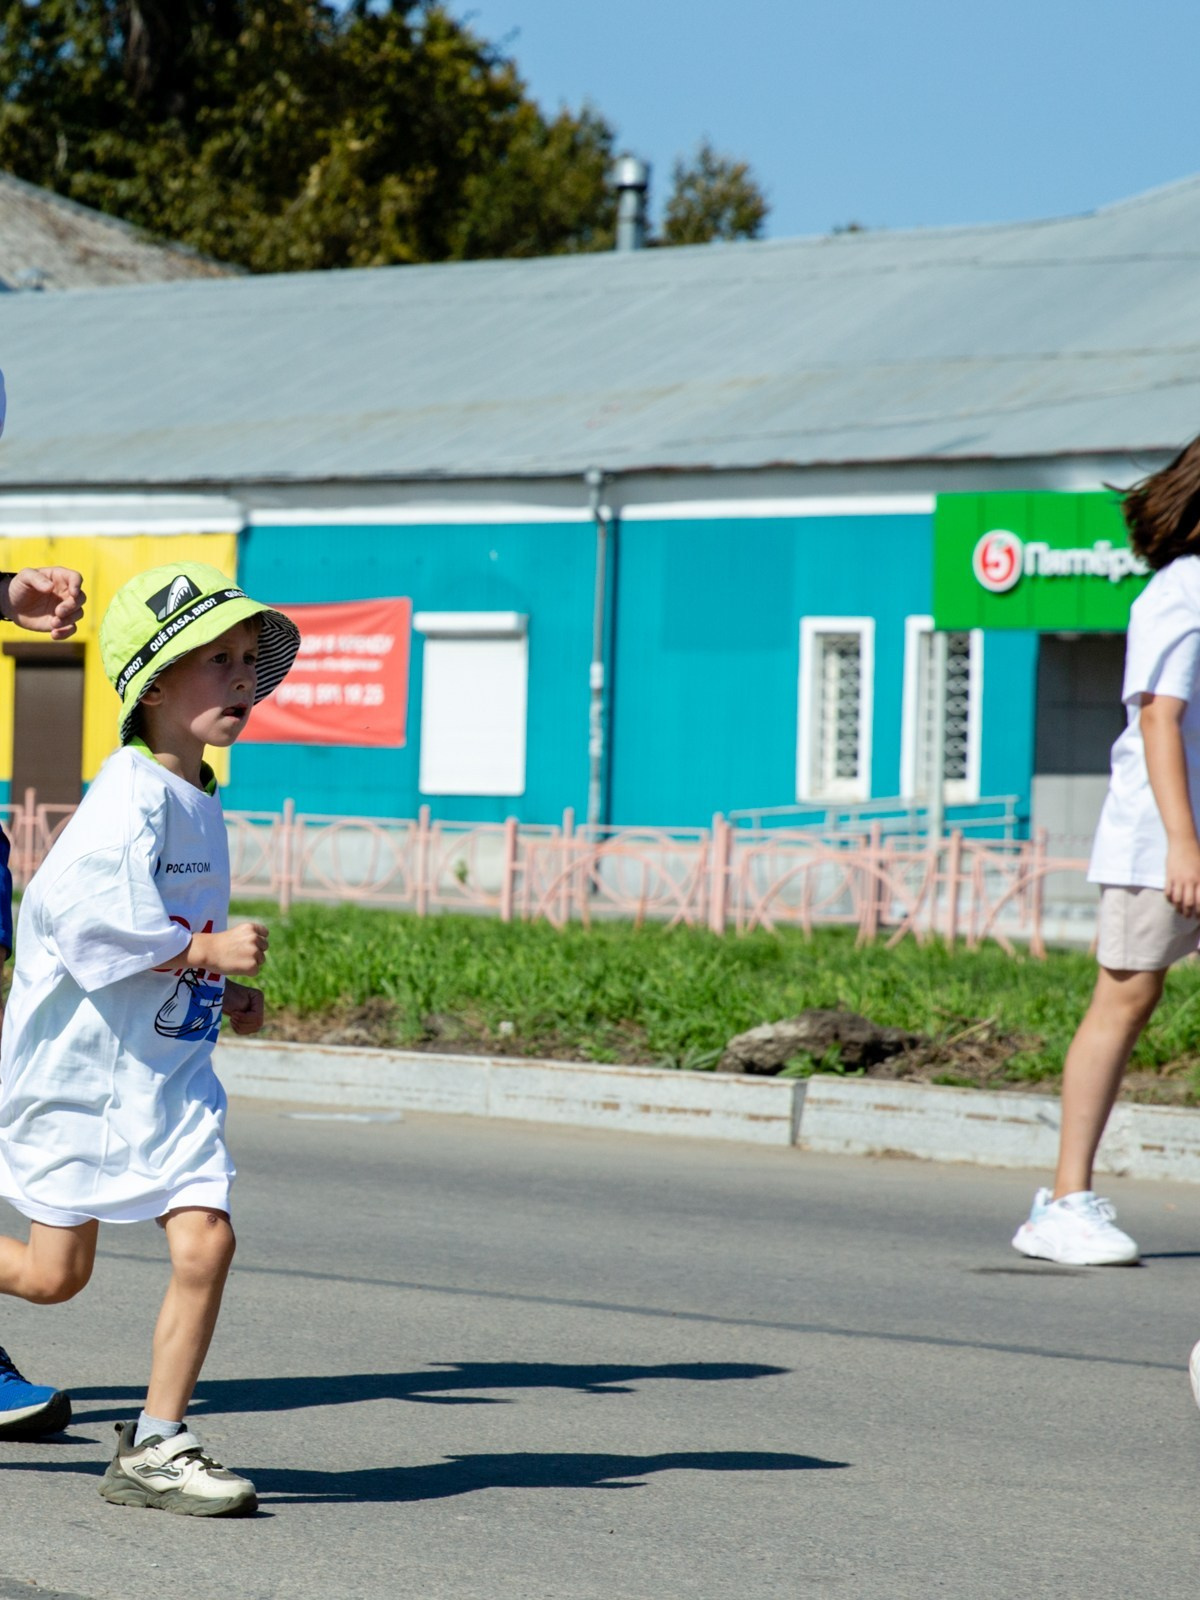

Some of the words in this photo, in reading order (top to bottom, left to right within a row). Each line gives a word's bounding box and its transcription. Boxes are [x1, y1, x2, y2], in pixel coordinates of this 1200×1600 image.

[124, 656, 144, 681] BRO?
[150, 630, 169, 653] QUÉ
[193, 597, 218, 618] BRO?
[165, 862, 211, 874] РОСАТОМ
